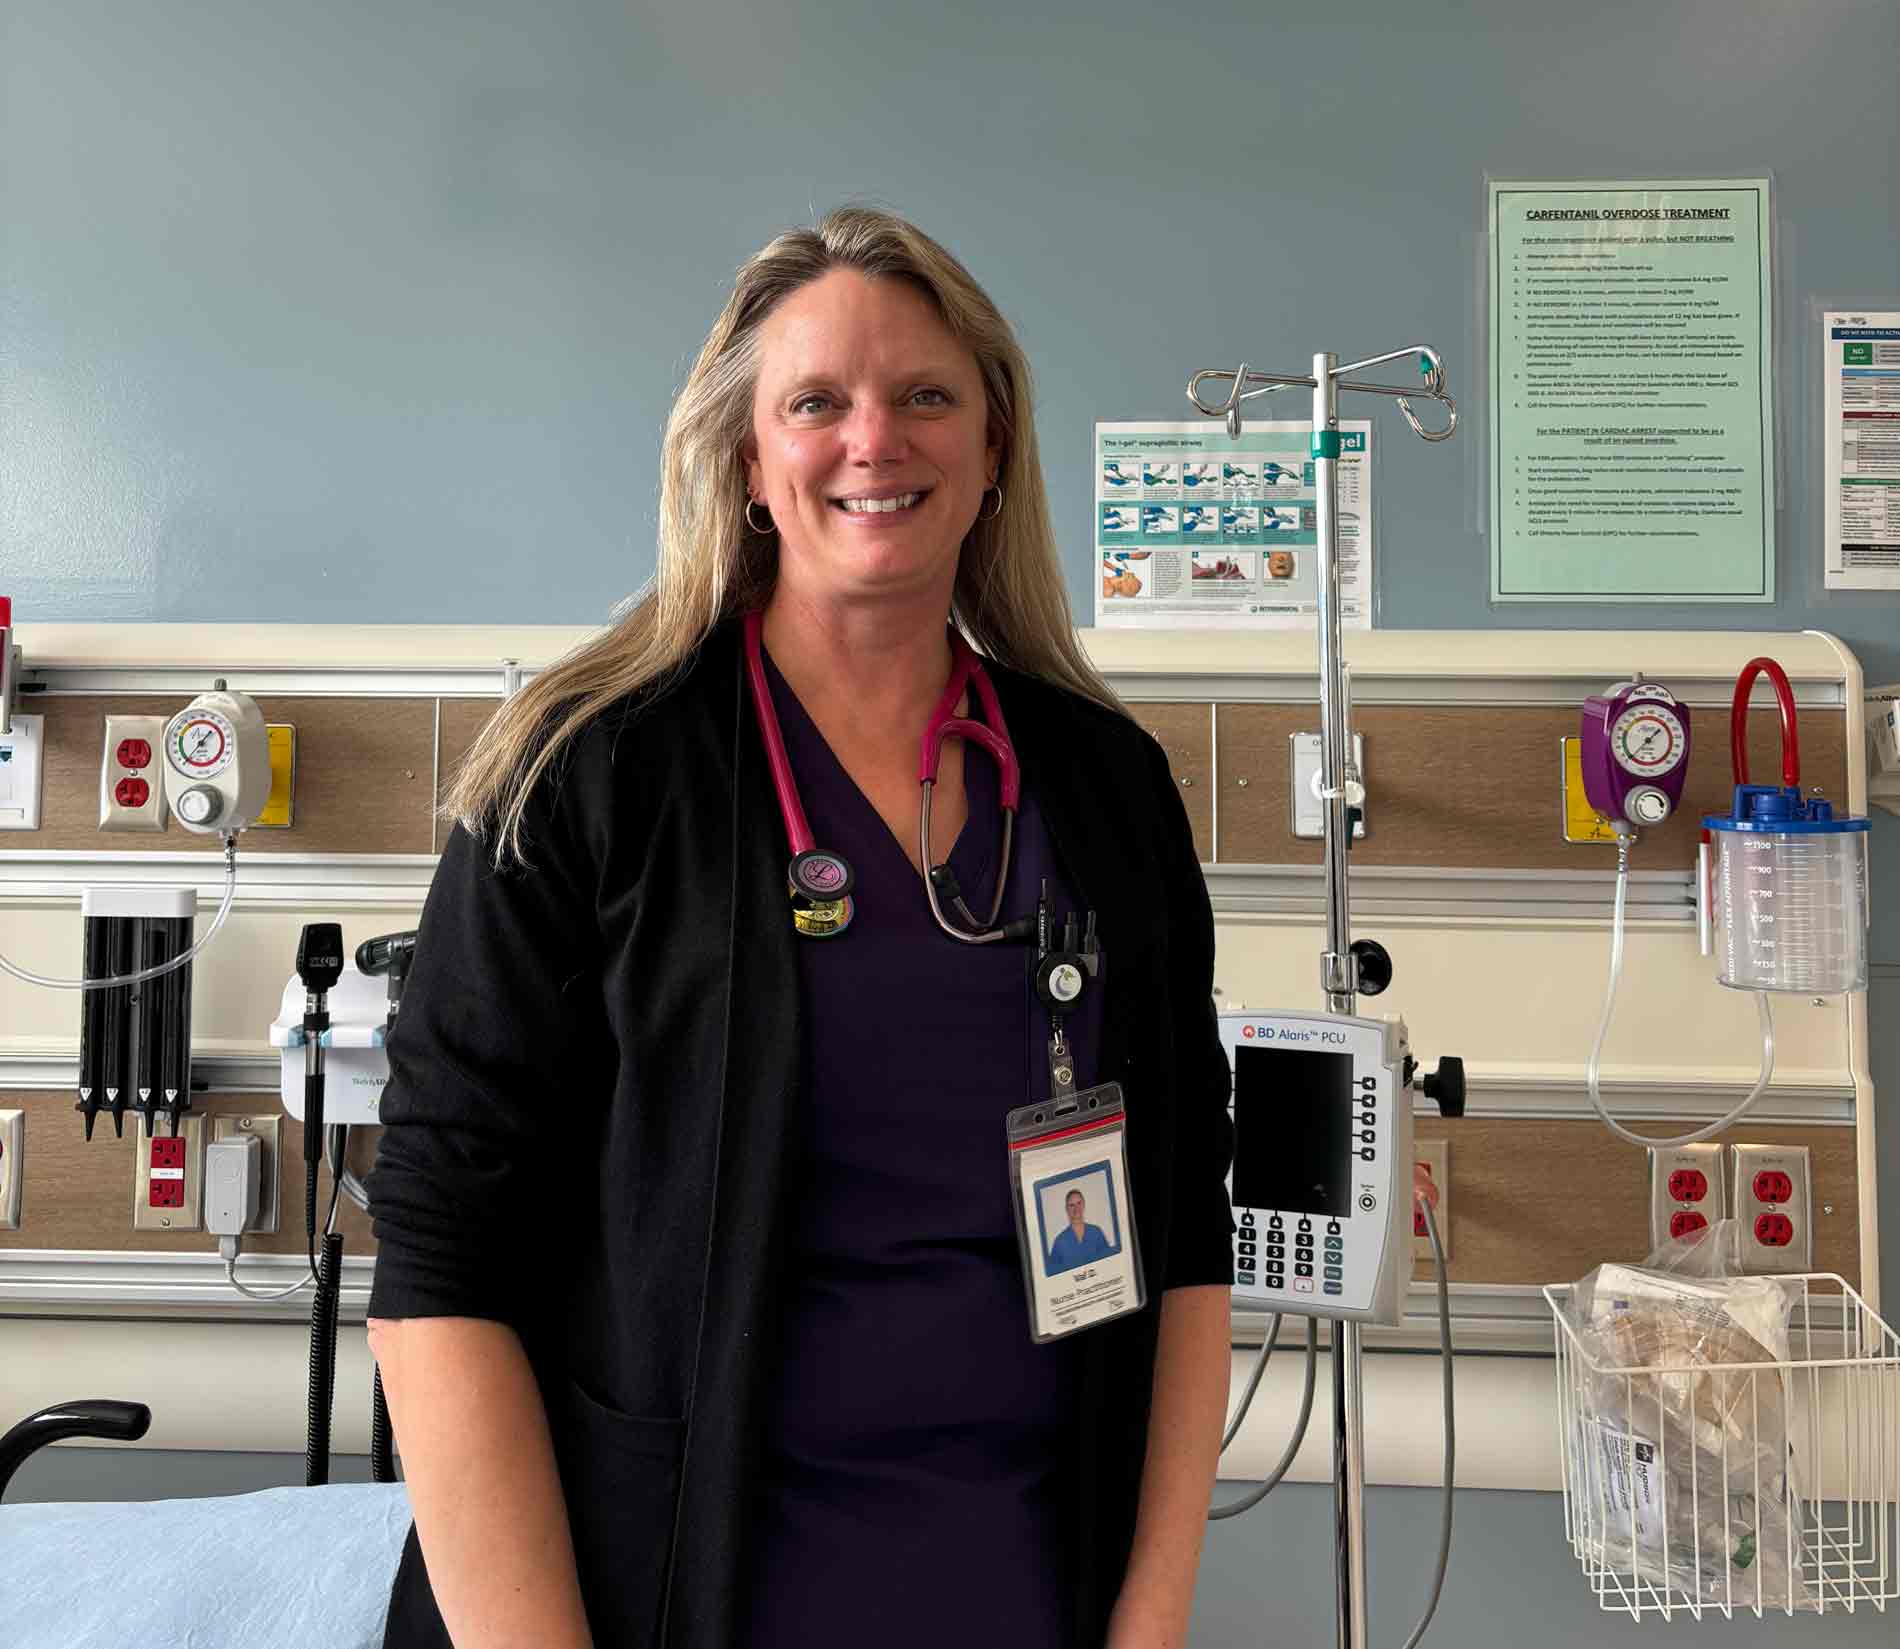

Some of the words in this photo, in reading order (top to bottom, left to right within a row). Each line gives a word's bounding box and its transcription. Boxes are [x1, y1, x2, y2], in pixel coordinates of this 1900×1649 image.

[1526, 209, 1600, 220] CARFENTANIL
[1601, 209, 1661, 220] OVERDOSE
[1663, 208, 1730, 220] TREATMENT
[1257, 1027, 1276, 1039] BD
[1321, 1031, 1346, 1044] PCU
[1272, 1233, 1280, 1241] 2
[1301, 1236, 1308, 1244] 3
[1243, 1245, 1250, 1253] 4
[1271, 1248, 1279, 1256] 5
[1300, 1251, 1308, 1259] 6
[1271, 1263, 1279, 1271] 8
[1300, 1266, 1307, 1274] 9
[1271, 1278, 1278, 1286] 0
